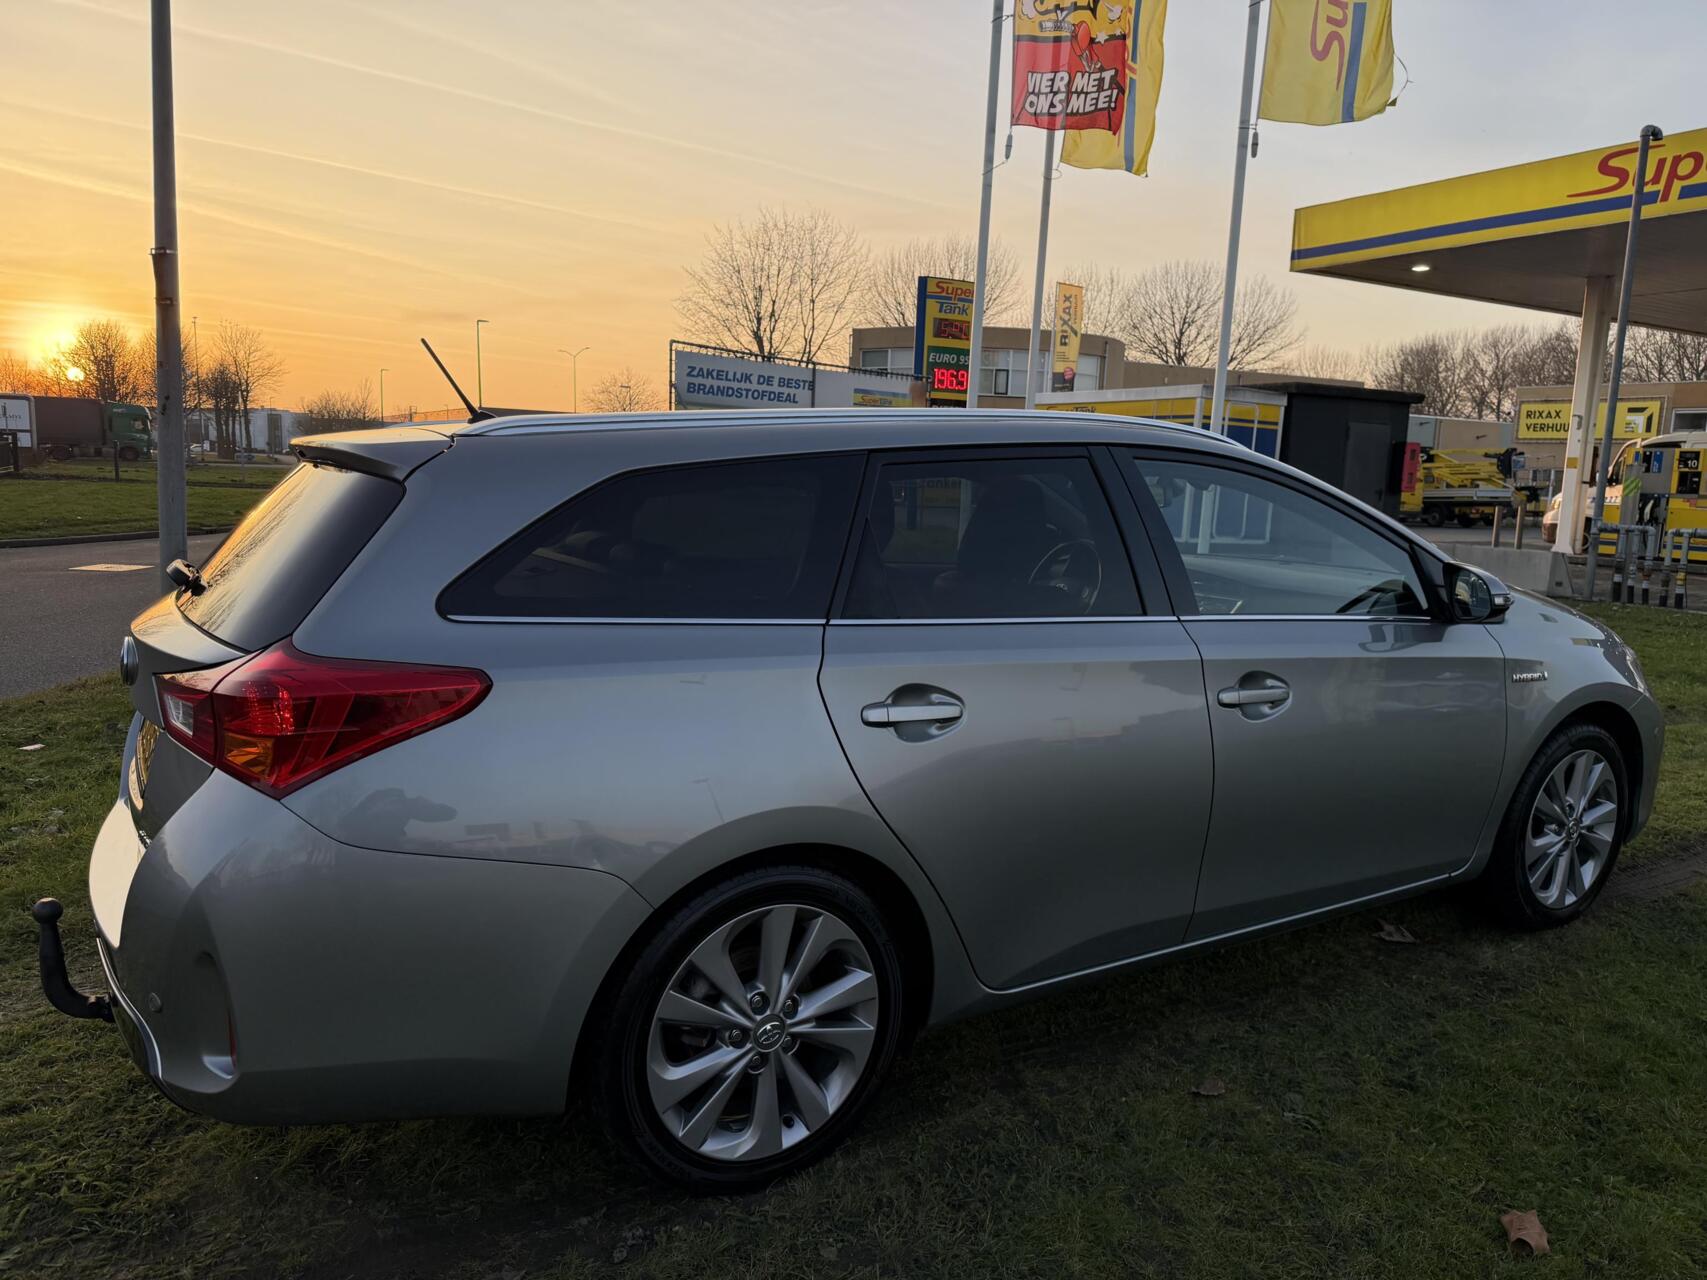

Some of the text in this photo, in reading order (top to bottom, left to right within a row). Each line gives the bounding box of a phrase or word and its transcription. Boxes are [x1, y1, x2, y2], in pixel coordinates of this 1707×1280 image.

[1027, 69, 1116, 93] VIER MET
[1024, 90, 1118, 113] ONS MEE!
[1566, 143, 1707, 204] Sup
[935, 301, 969, 316] Tank
[1060, 294, 1078, 347] RIXAX
[929, 353, 957, 364] EURO
[686, 365, 816, 391] ZAKELIJK DE BESTE
[686, 382, 799, 404] BRANDSTOFDEAL
[1526, 410, 1562, 420] RIXAX
[1687, 459, 1698, 468] 10
